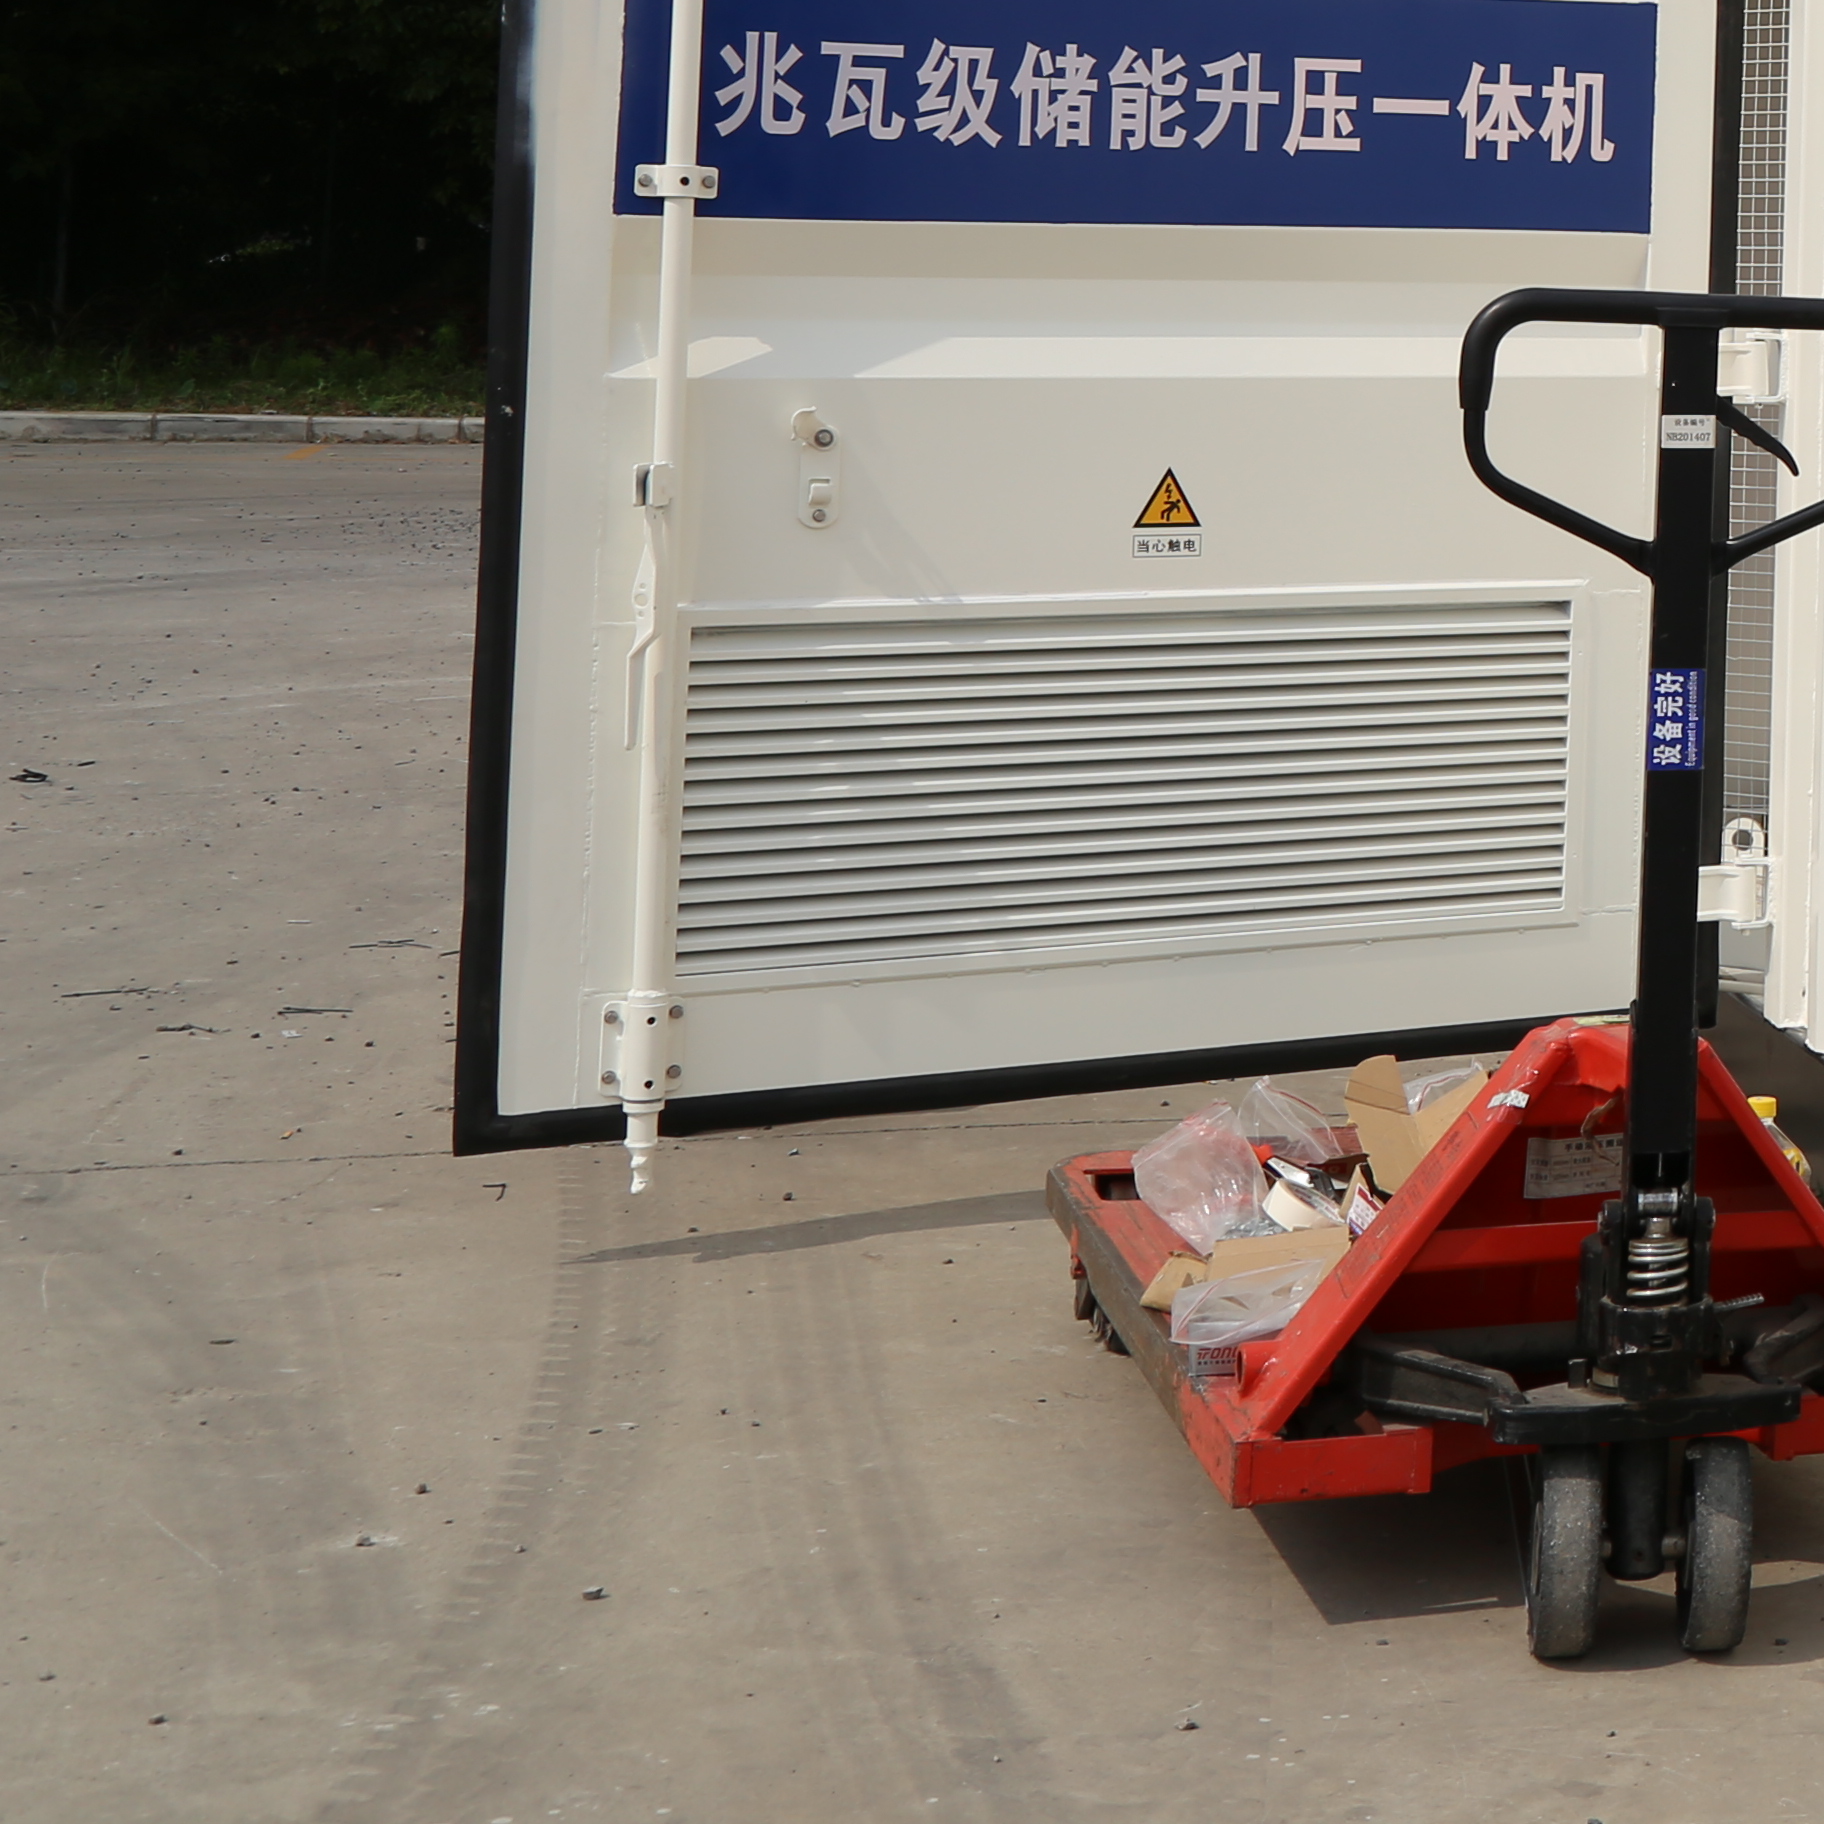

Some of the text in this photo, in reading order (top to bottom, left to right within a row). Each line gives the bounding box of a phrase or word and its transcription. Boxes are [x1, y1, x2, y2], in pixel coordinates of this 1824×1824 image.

[715, 31, 1616, 164] 兆瓦级储能升压一体机
[1136, 538, 1197, 553] 当心触电
[1687, 671, 1698, 703] condition
[1652, 671, 1684, 766] 设备完好
[1686, 704, 1699, 721] good
[1684, 730, 1698, 767] Equipment
